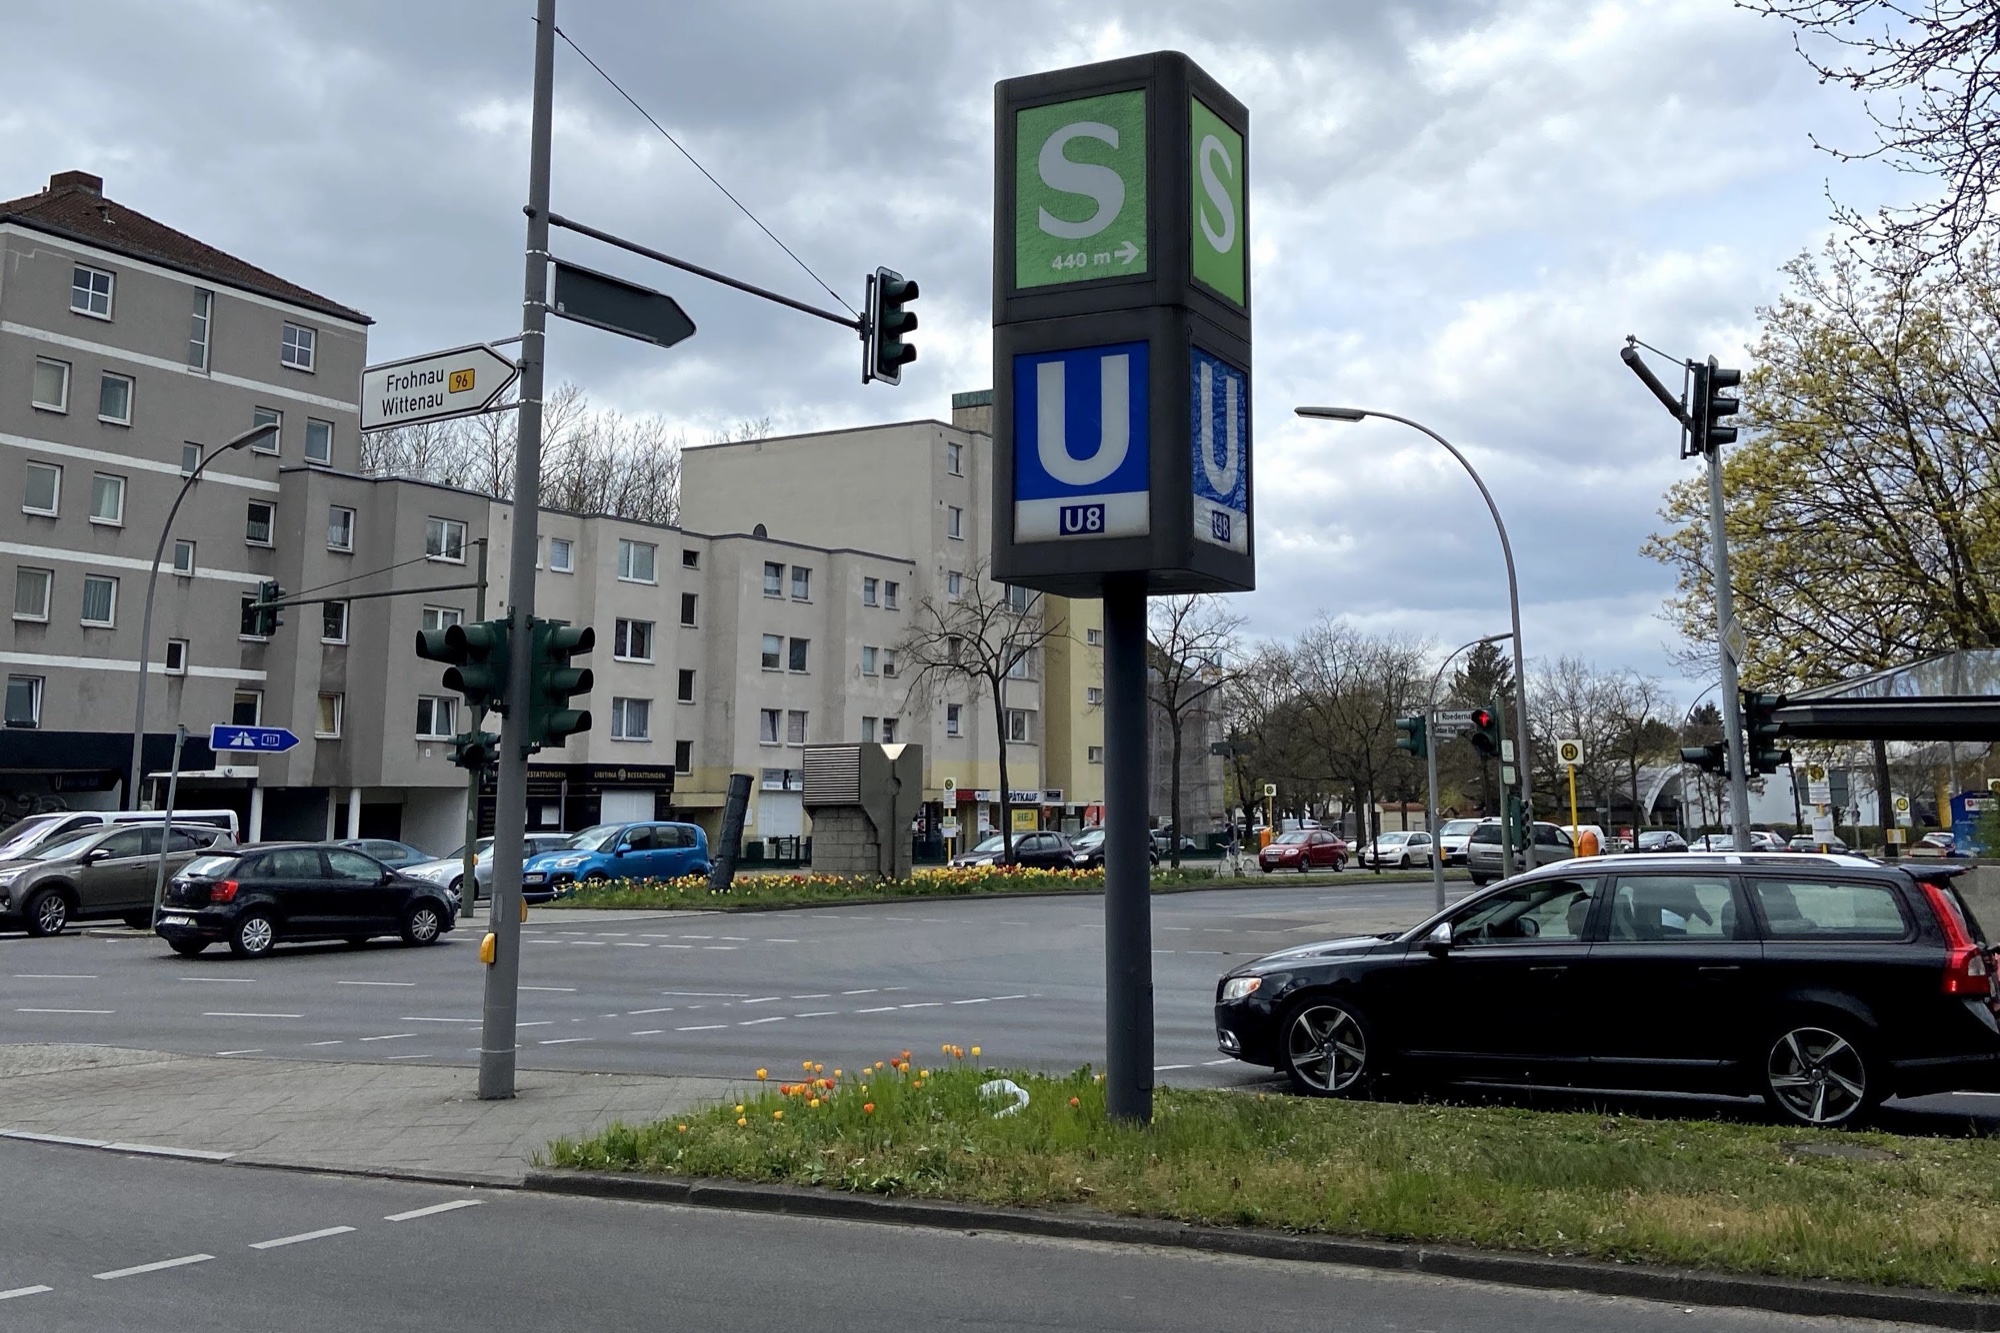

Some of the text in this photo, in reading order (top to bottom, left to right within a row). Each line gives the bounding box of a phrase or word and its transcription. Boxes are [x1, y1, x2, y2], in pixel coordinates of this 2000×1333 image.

[1038, 121, 1126, 240] S
[1199, 134, 1235, 254] S
[1052, 253, 1111, 270] 440 m
[386, 369, 468, 393] Frohnau 96
[382, 392, 444, 417] Wittenau
[1037, 353, 1130, 486] U
[1200, 360, 1238, 496] U
[1064, 507, 1101, 532] U8
[1213, 511, 1230, 541] U8
[527, 770, 566, 778] ESTATTUNGEN
[1008, 791, 1038, 801] PÄTKAUF
